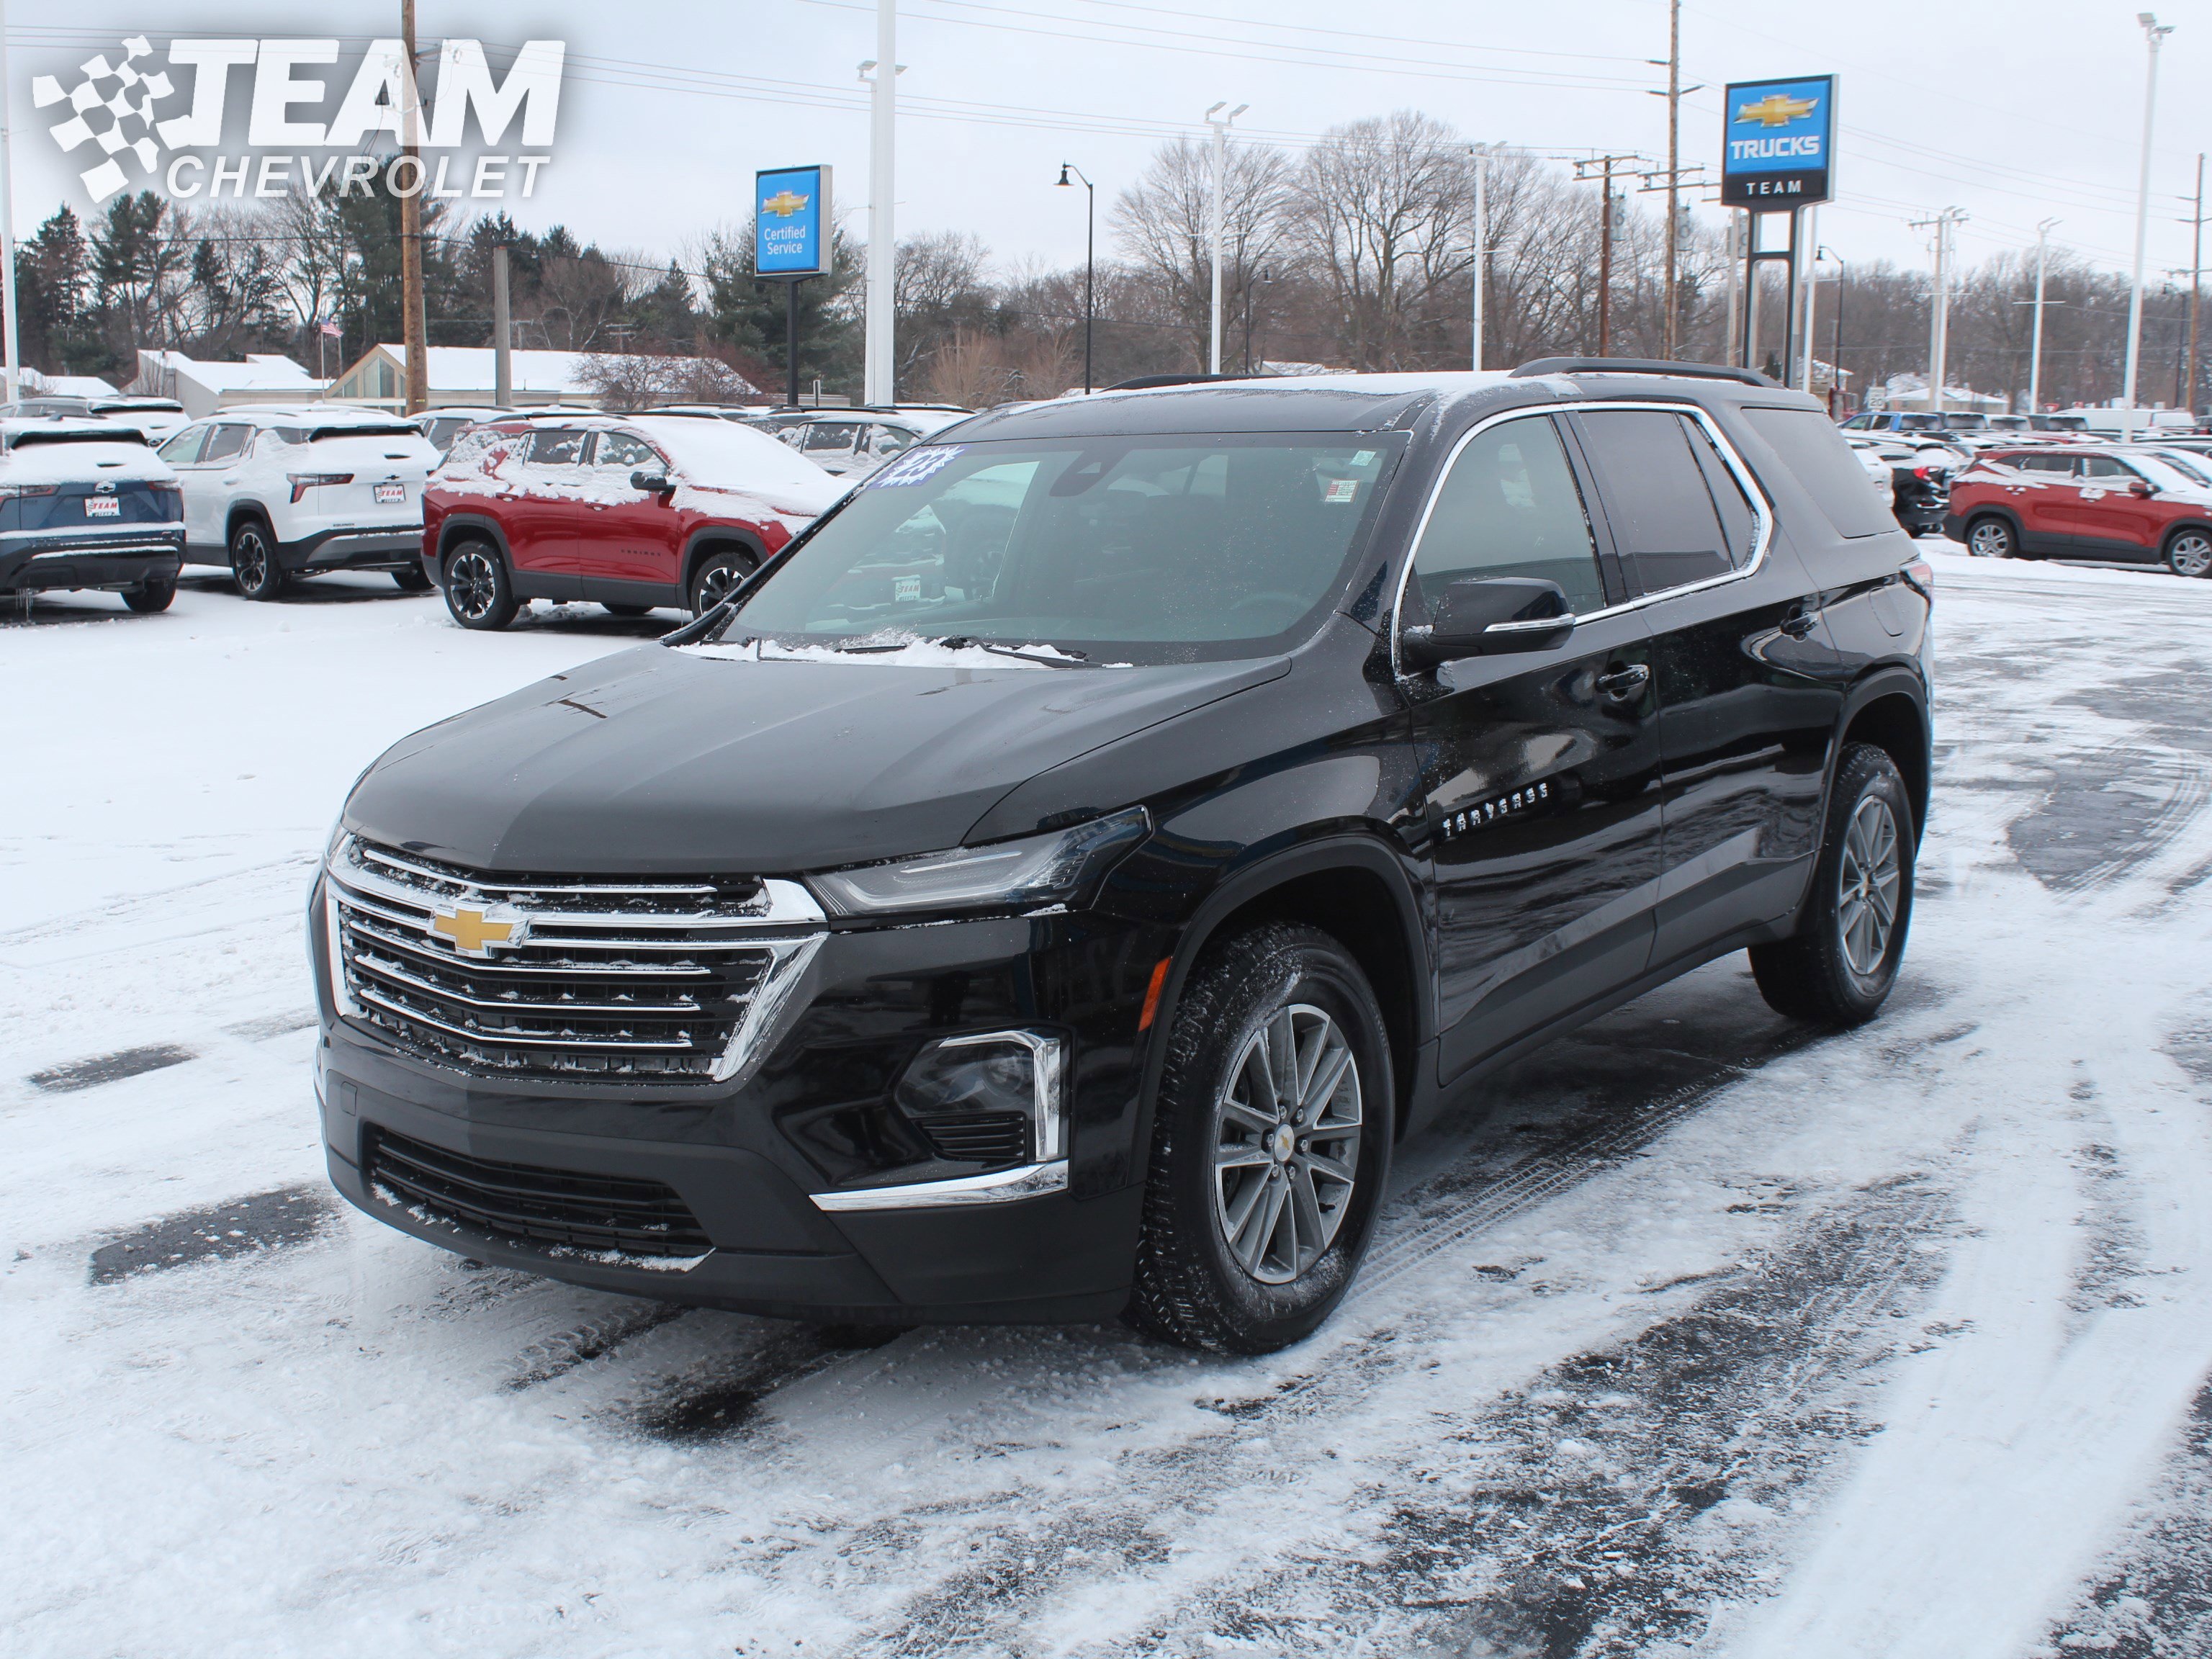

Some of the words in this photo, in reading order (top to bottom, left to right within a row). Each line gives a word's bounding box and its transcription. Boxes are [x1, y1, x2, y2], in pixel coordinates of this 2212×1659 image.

[1730, 135, 1820, 160] TRUCKS
[1745, 180, 1802, 195] TEAM
[764, 225, 806, 241] Certified
[767, 241, 803, 255] Service
[900, 584, 920, 593] TEAM
[1442, 782, 1548, 837] TRAVERSE
